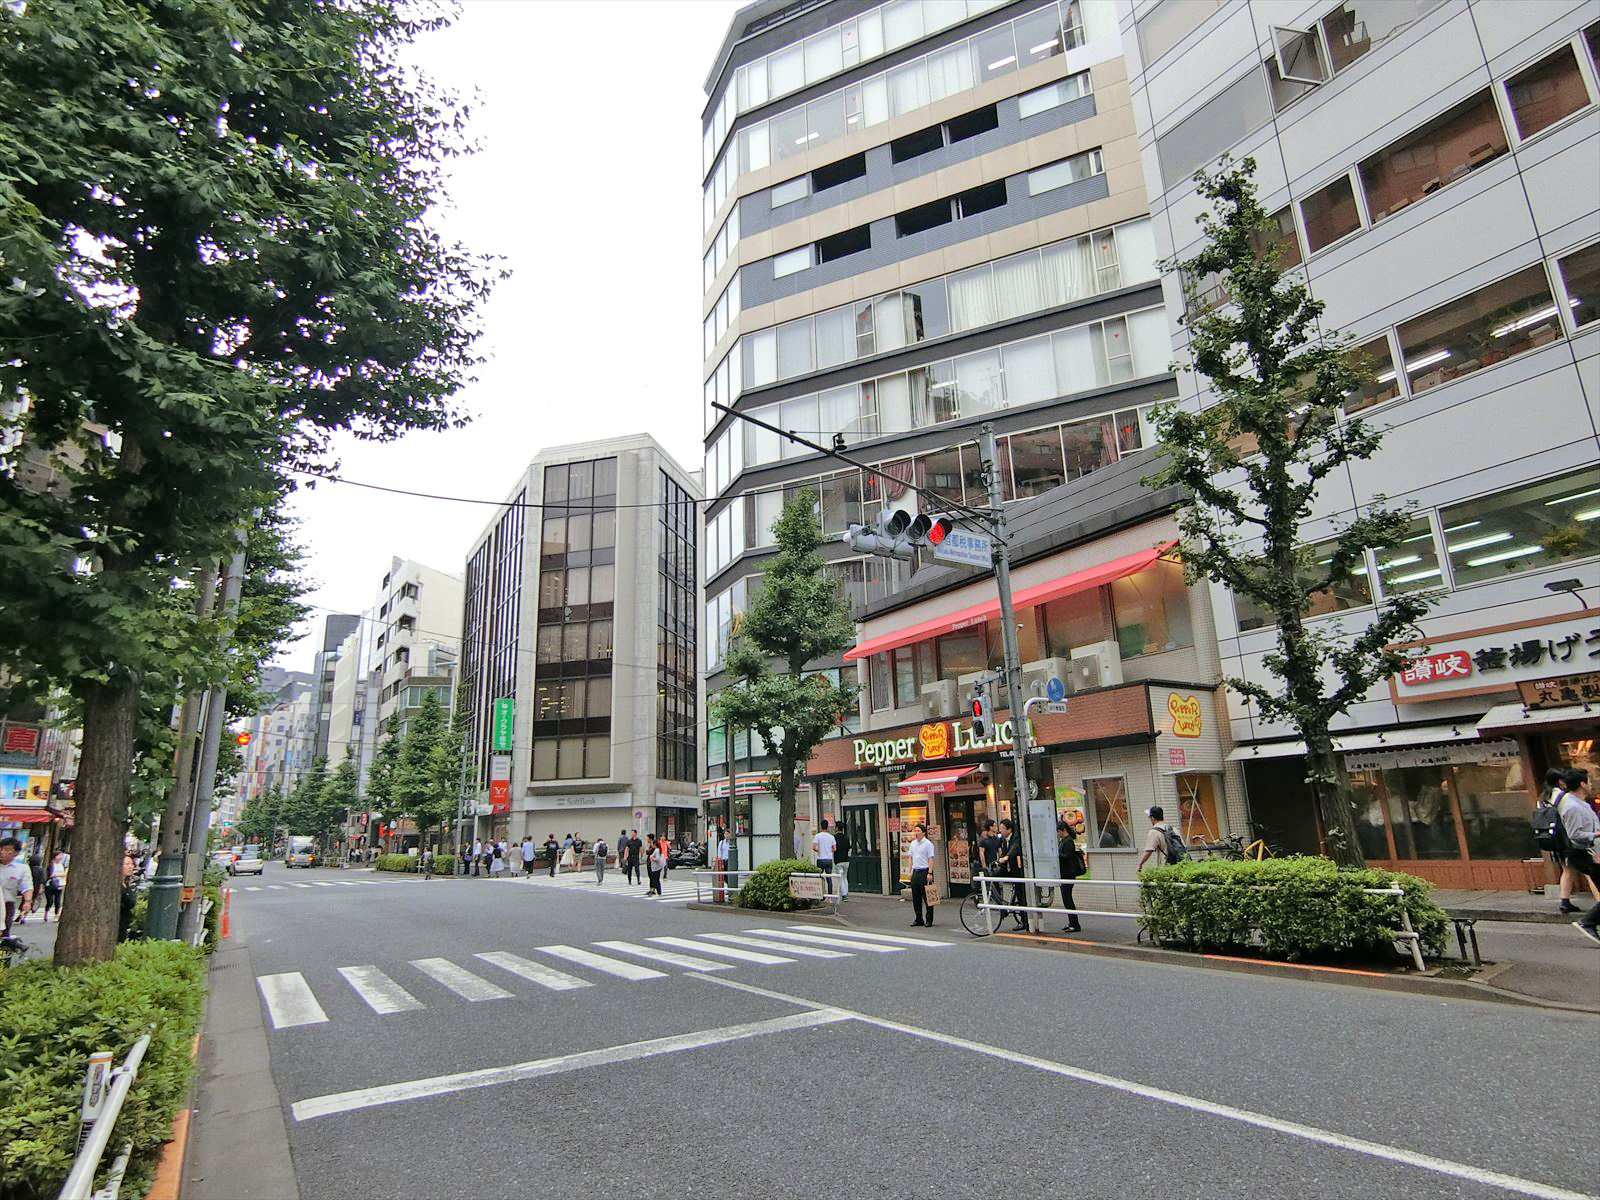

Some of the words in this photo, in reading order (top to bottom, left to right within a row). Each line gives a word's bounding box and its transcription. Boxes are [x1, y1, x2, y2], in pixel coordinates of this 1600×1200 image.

[853, 737, 917, 766] Pepper
[907, 786, 925, 794] Pepper
[927, 784, 945, 792] Lunch
[566, 797, 596, 806] SoftBank
